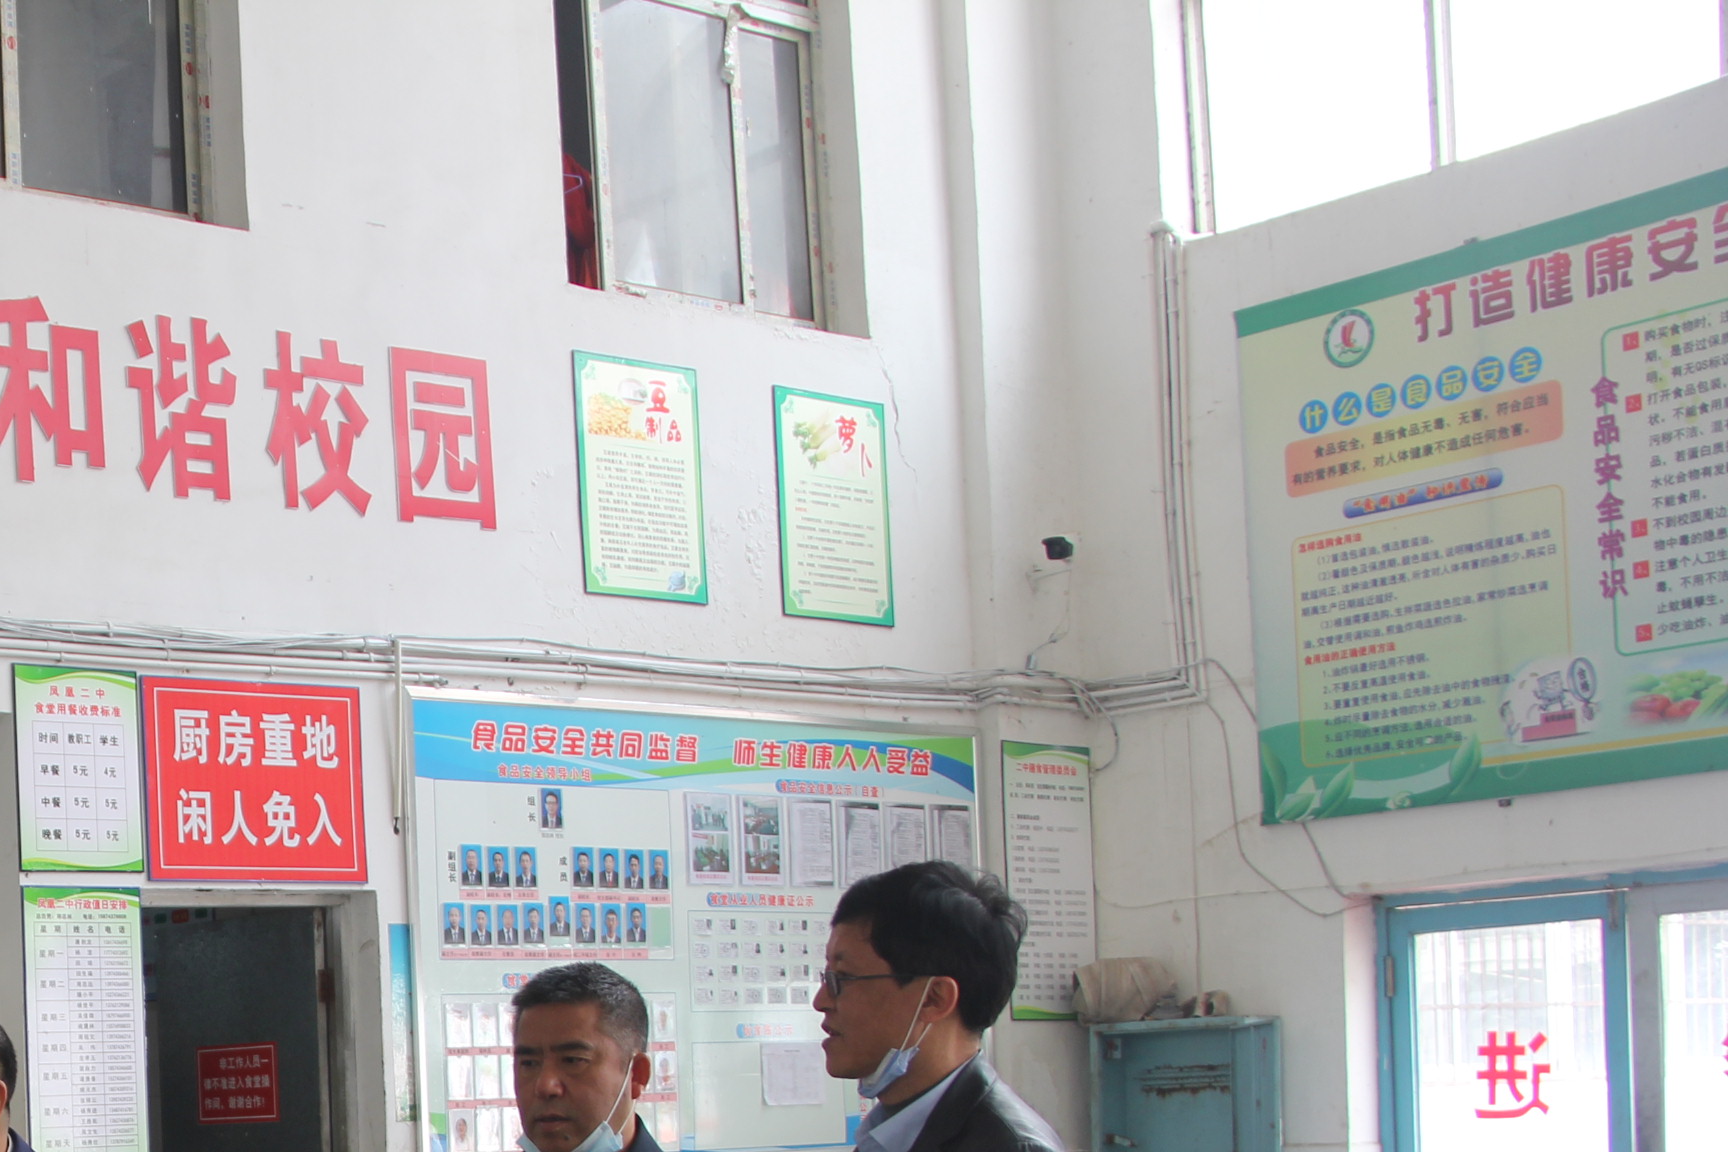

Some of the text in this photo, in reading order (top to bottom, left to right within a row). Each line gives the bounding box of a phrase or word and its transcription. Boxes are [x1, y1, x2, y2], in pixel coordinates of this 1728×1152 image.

[645, 380, 670, 414] 豆
[1303, 350, 1539, 429] 什么是食品安全
[834, 415, 873, 477] 萝卜
[1590, 375, 1628, 601] 食品安全常识
[1650, 461, 1728, 489] 水化合物有发
[49, 685, 106, 700] 凤凰二中
[34, 702, 122, 718] 食堂用餐收费标准
[38, 732, 119, 747] 时间 教职工 学生
[173, 708, 339, 769] 厨房重地
[472, 720, 932, 776] 食品安全共同监督 师生健康人人受益
[39, 764, 117, 778] 早餐 5元 4元
[497, 763, 592, 782] 食品安全领导小组
[41, 796, 118, 810] 中餐 5元 5元
[527, 796, 536, 822] 组长
[176, 788, 343, 848] 闲人免入
[42, 828, 119, 842] 晚餐 5元 5元
[559, 856, 569, 882] 成员
